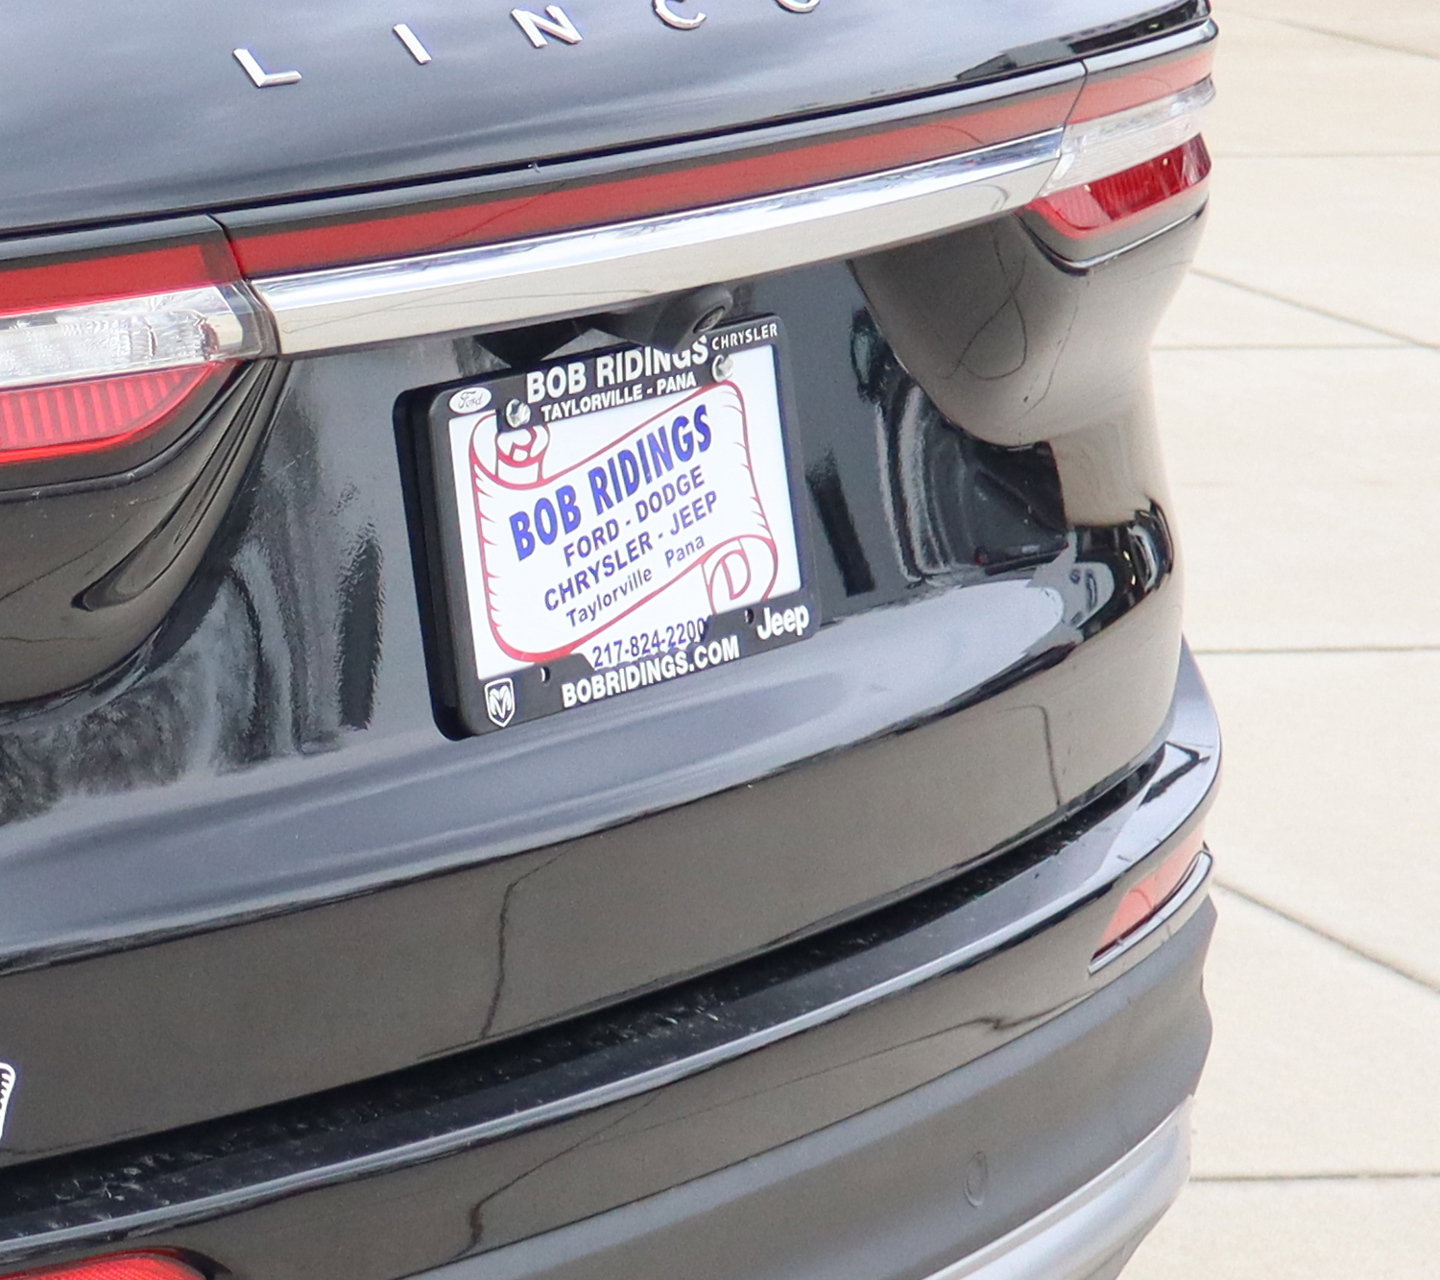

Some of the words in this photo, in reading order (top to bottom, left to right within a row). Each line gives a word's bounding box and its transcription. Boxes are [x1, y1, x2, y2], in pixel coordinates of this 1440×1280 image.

[526, 360, 588, 405] BOB
[595, 334, 711, 388] RIDINGS
[710, 322, 779, 351] CHRYSLER
[540, 382, 644, 424] TAYLORVILLE
[655, 370, 698, 397] PANA
[508, 484, 583, 562] BOB
[587, 403, 713, 505] RIDINGS
[562, 516, 621, 569] FORD
[635, 464, 707, 526] DODGE
[543, 532, 655, 613] CHRYSLER
[669, 489, 719, 540] JEEP
[565, 566, 653, 629] Taylorville
[664, 533, 706, 568] Pana
[591, 616, 707, 668] 217-824-2200
[756, 603, 810, 641] Jeep
[560, 635, 741, 709] BOBRIDINGS.COM
